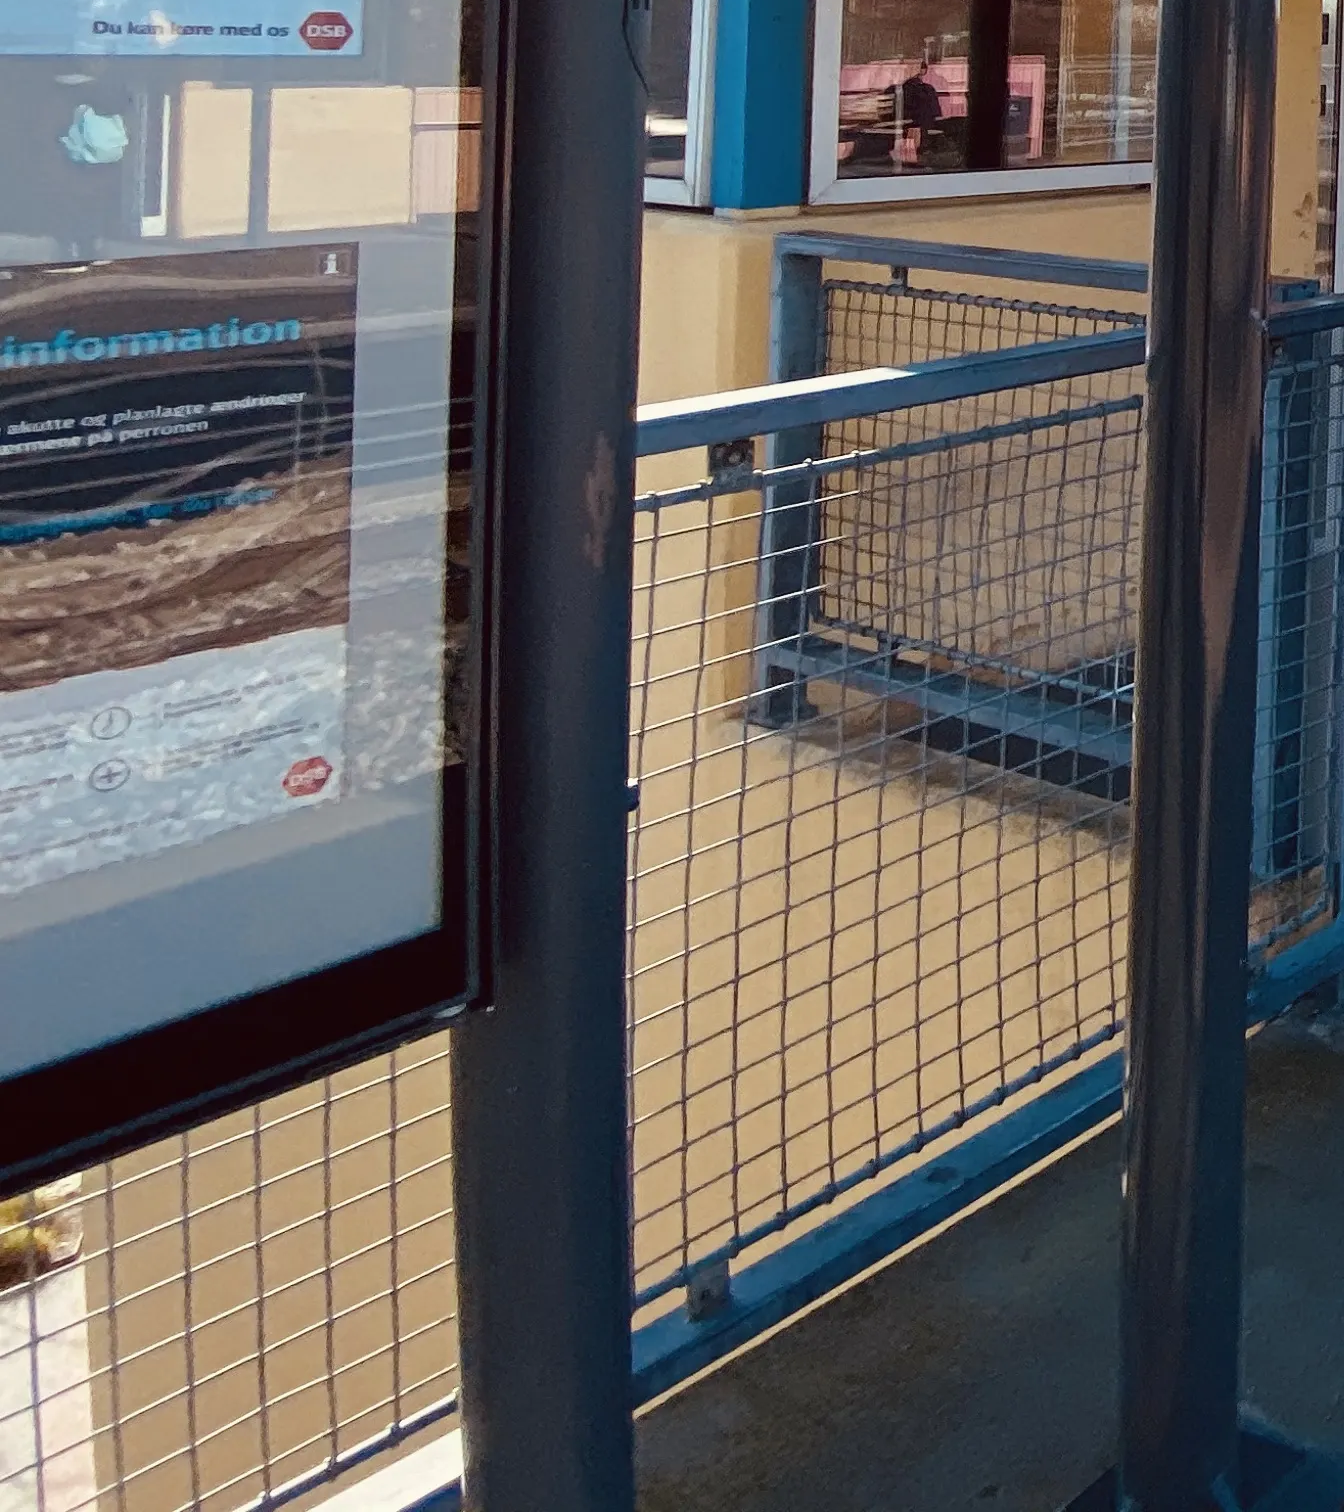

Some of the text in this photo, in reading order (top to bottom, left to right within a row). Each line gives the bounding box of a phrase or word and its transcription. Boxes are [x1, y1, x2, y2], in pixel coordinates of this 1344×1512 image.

[92, 20, 122, 35] Du
[220, 23, 262, 37] med
[267, 26, 289, 38] os
[307, 24, 347, 38] DSB
[0, 317, 302, 368] information
